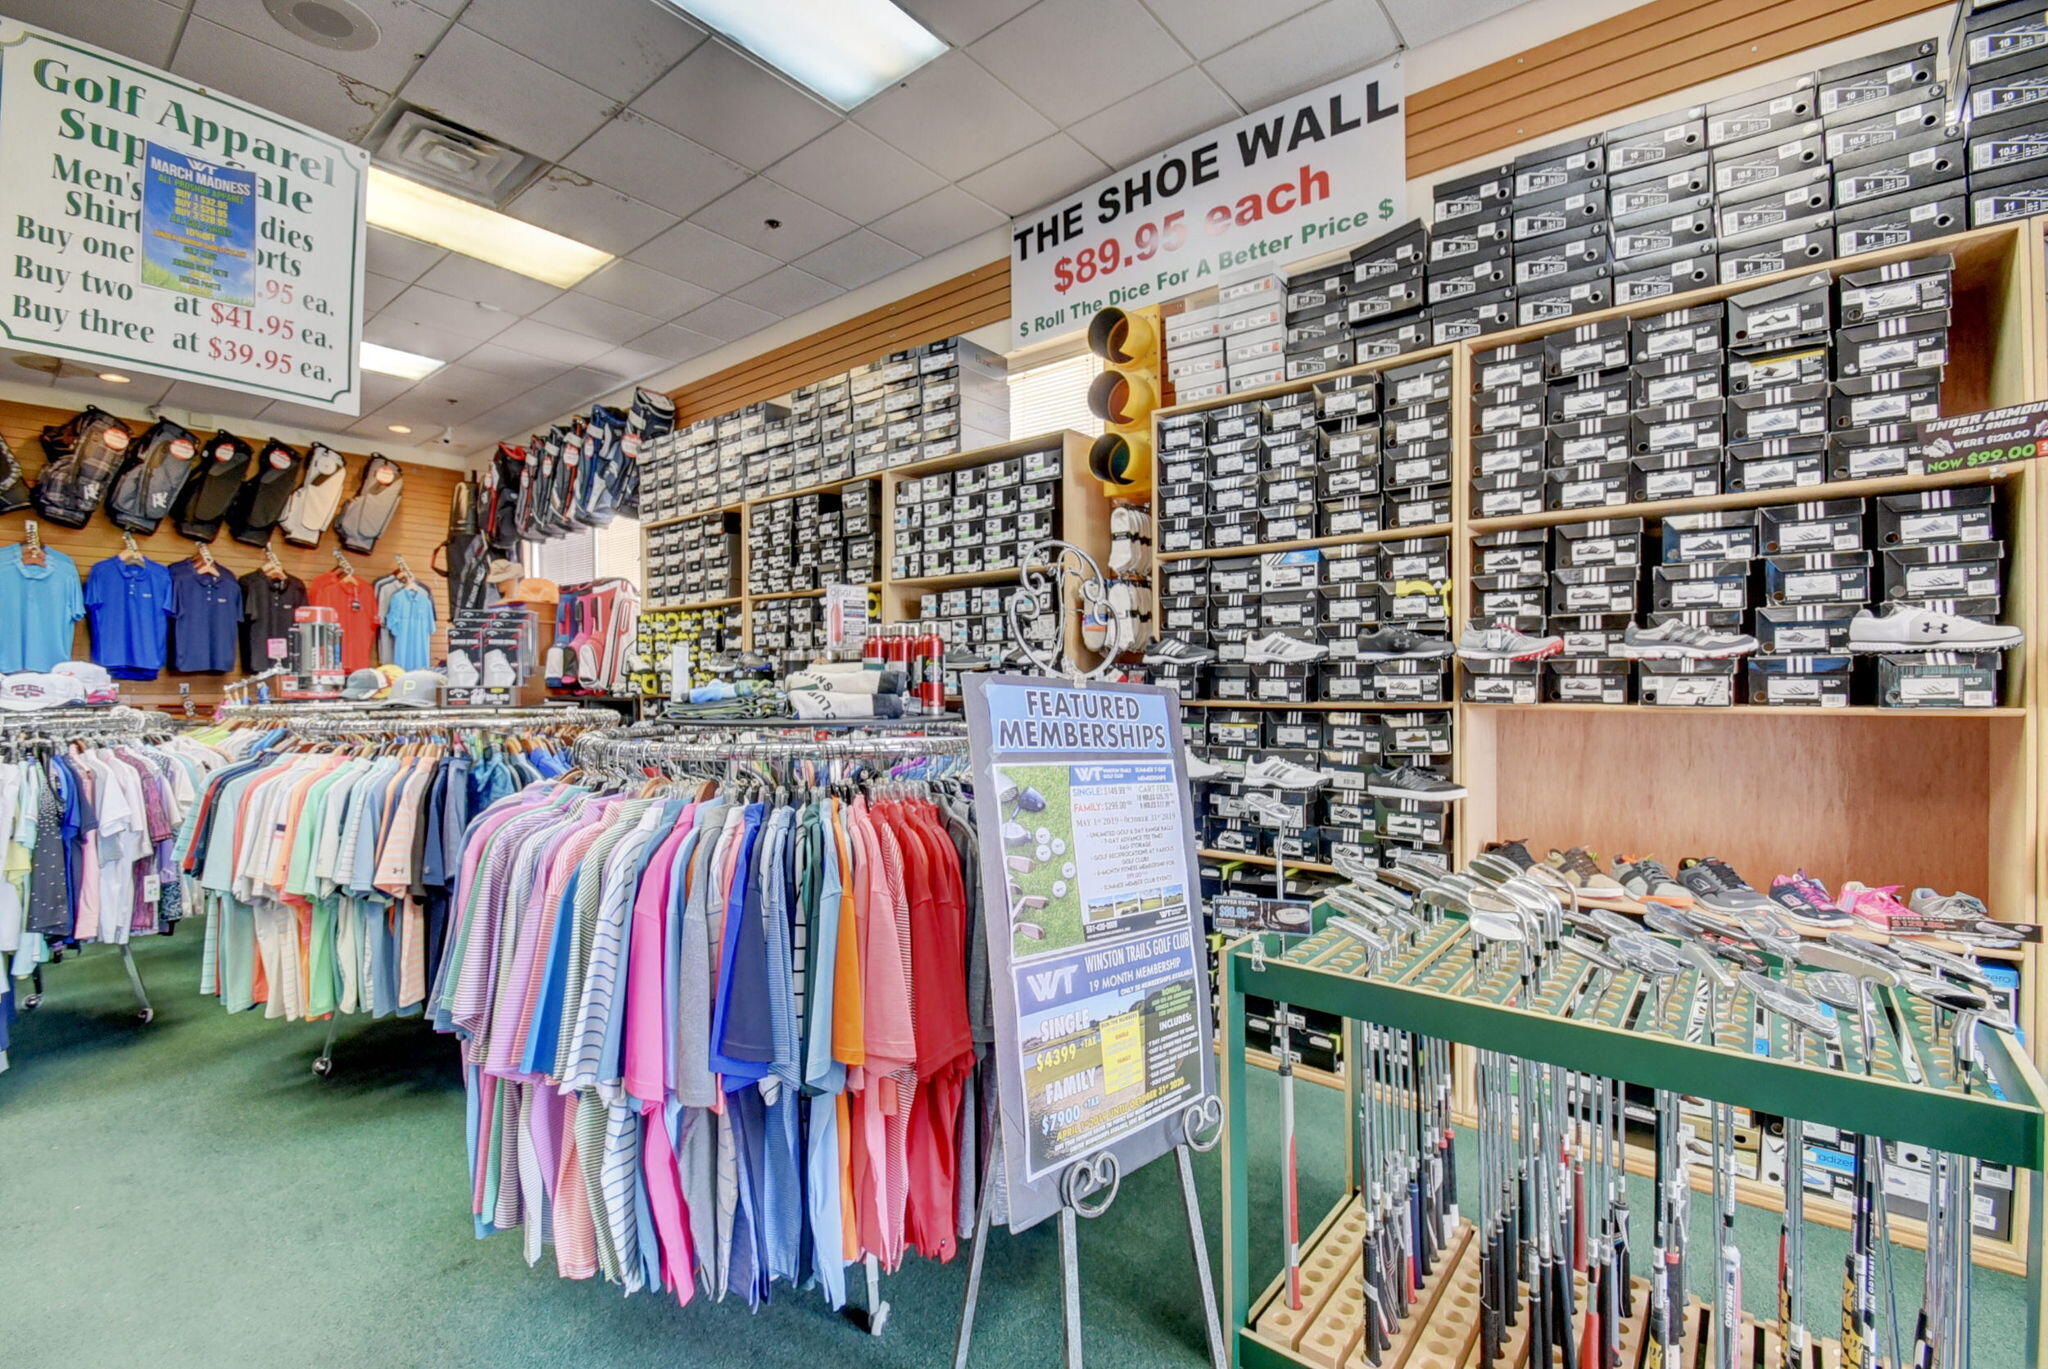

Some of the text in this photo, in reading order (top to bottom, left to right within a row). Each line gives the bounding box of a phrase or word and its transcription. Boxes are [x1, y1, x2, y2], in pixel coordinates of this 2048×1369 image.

[1998, 37, 2011, 48] 10
[33, 57, 335, 188] Golf Apparel
[58, 107, 146, 168] Sup
[1998, 144, 2018, 157] 10.5
[151, 157, 251, 197] MARCH MADNESS
[1014, 80, 1399, 261] THE SHOE WALL
[52, 152, 143, 201] Men's
[261, 215, 314, 252] dies
[2003, 201, 2017, 212] 11
[1054, 165, 1330, 295] $89.95 each
[16, 214, 71, 248] Buy
[83, 237, 134, 263] one
[302, 291, 335, 316] ea.
[1019, 198, 1395, 338] $ Roll The Dice For A Better Price $
[15, 255, 333, 350] Buy two at $41.95 ea.
[13, 294, 332, 384] Buy three at $39.95 ea.
[1925, 414, 1982, 433] UNDER
[1952, 415, 2028, 436] GOLF SHOES
[1953, 437, 1985, 450] WERE
[1927, 458, 1963, 473] NOW
[403, 680, 416, 696] P
[1026, 690, 1140, 720] FEATURED
[1000, 720, 1166, 749] MEMBERSHIPS
[1074, 767, 1103, 782] WT
[1084, 932, 1190, 973] WINSTON TRAILS GOLF CLUB
[1026, 964, 1078, 1002] WT
[1089, 956, 1182, 993] 19 MONTH MEMBERSHIP
[1040, 1008, 1091, 1042] SINGLE
[1159, 1012, 1193, 1031] INCLUDES:
[1036, 1043, 1077, 1073] $4399
[1045, 1066, 1097, 1105] FAMILY
[1041, 1105, 1080, 1136] $7900
[1056, 1125, 1079, 1142] APRIL
[1109, 1103, 1129, 1119] UNTIL
[1129, 1089, 1157, 1109] OCTOBER
[1170, 1077, 1185, 1090] 2020
[1819, 1154, 1854, 1167] adizer
